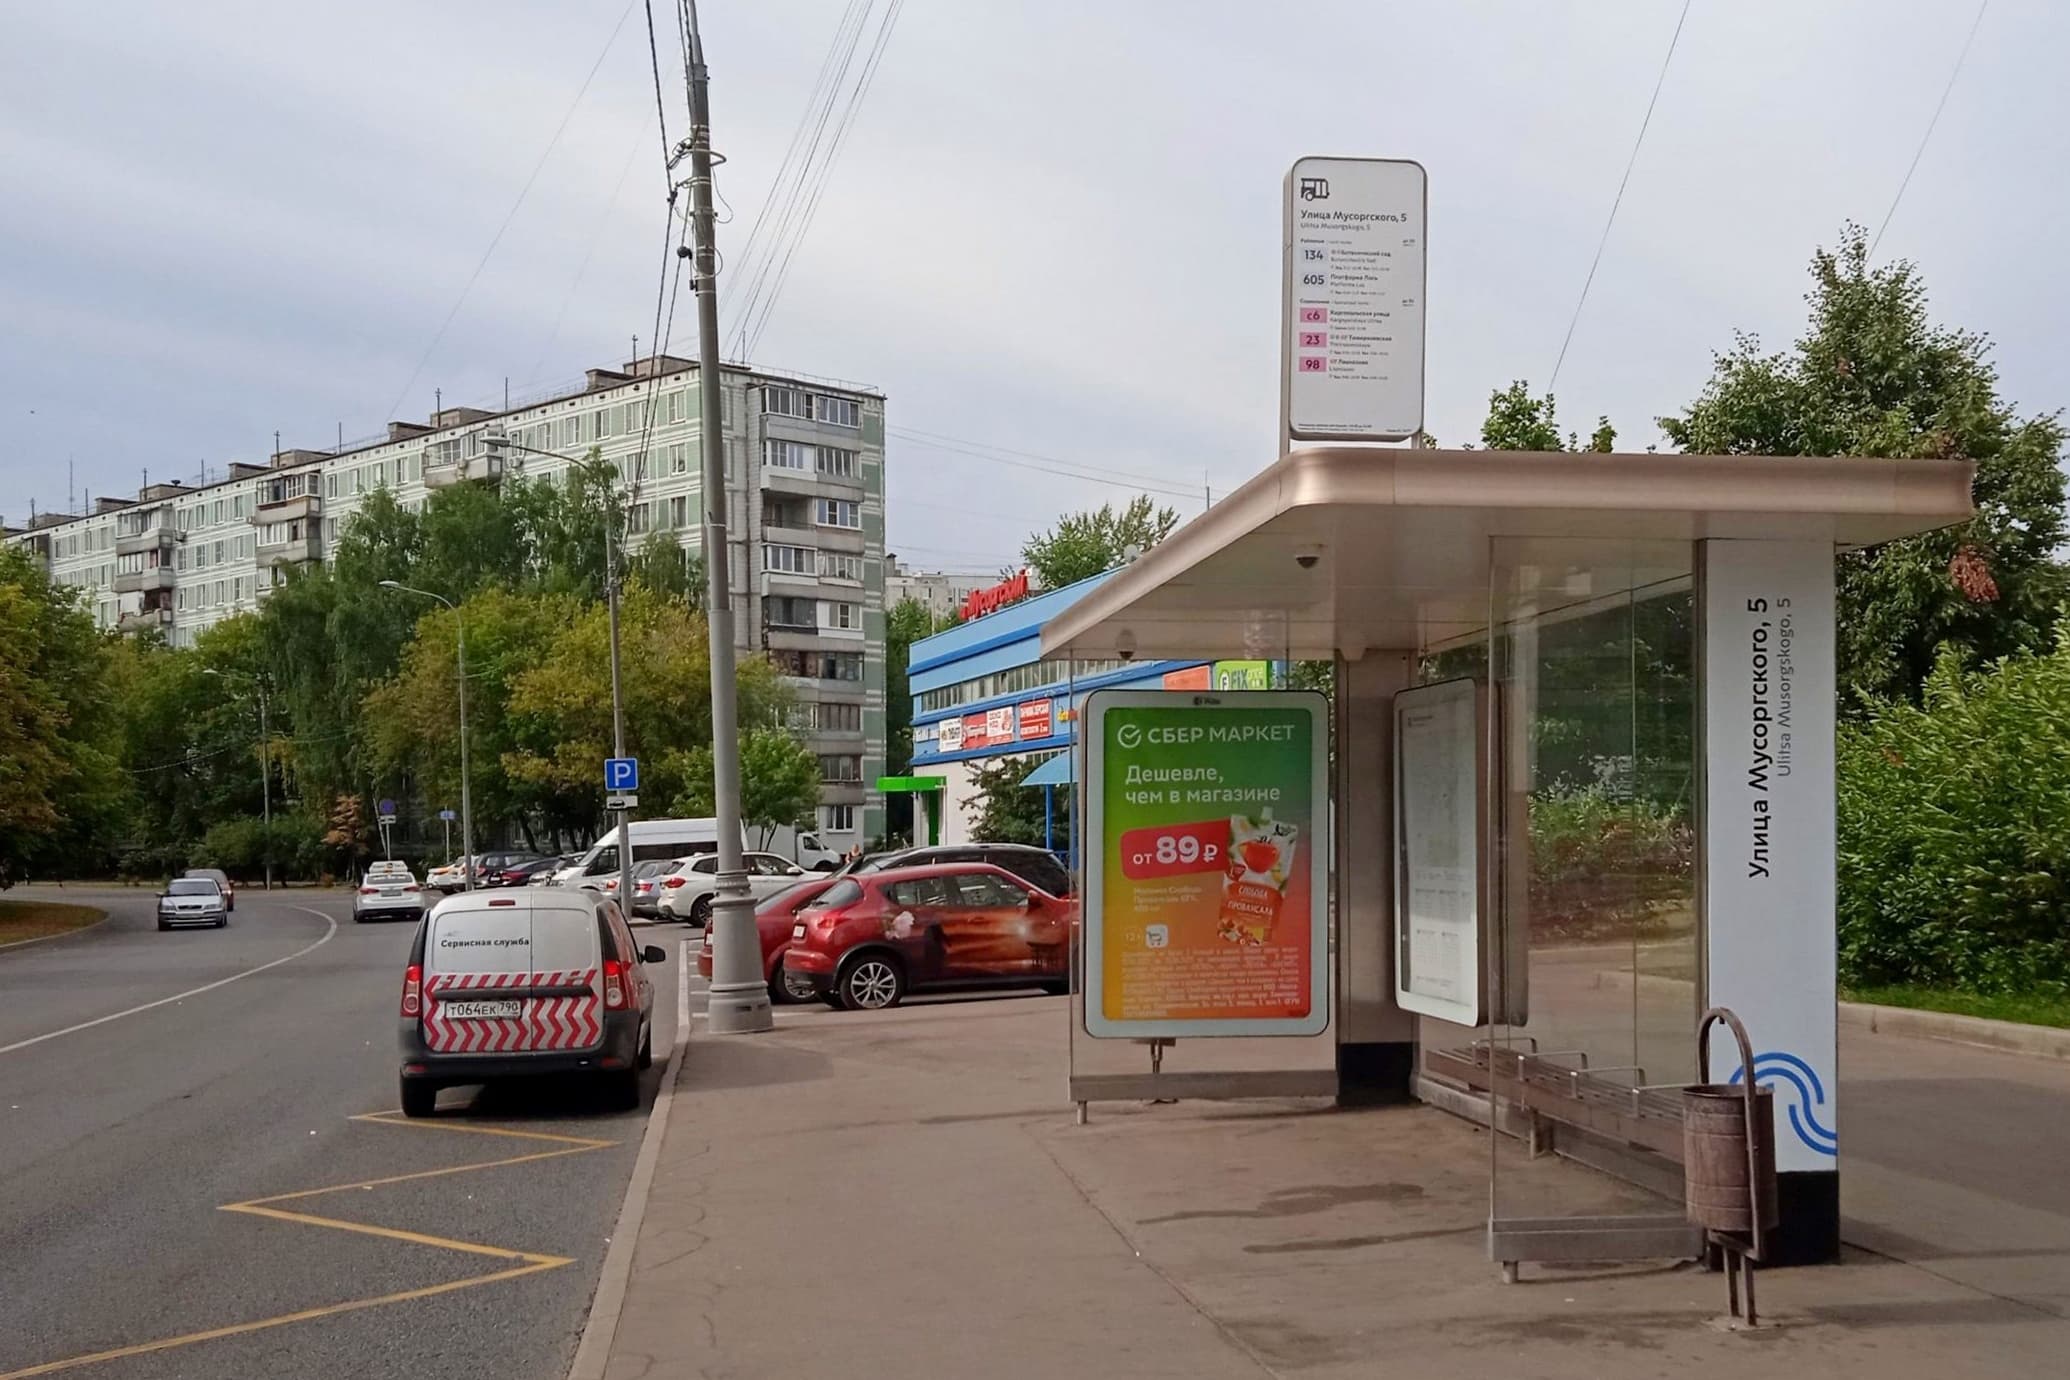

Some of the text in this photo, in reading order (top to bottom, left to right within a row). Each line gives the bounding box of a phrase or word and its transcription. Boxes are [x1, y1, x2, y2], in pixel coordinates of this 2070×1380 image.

[1301, 210, 1407, 223] Улица Мусоргского, 5
[1305, 250, 1323, 260] 134
[1304, 275, 1324, 285] 605
[1306, 335, 1320, 345] 23
[1306, 360, 1320, 370] 98
[1231, 669, 1248, 690] FIX
[1777, 597, 1794, 777] Ulitsa Musorgskogo, 5
[1148, 724, 1296, 744] СБЕР МАРКЕТ
[1747, 598, 1773, 878] Улица Мусоргского, 5
[614, 763, 631, 787] P
[1125, 765, 1224, 785] Дешевле,
[1126, 787, 1281, 804] чем в магазине
[1133, 853, 1152, 865] от
[1156, 835, 1200, 864] 89
[441, 936, 530, 949] Сервисная служба
